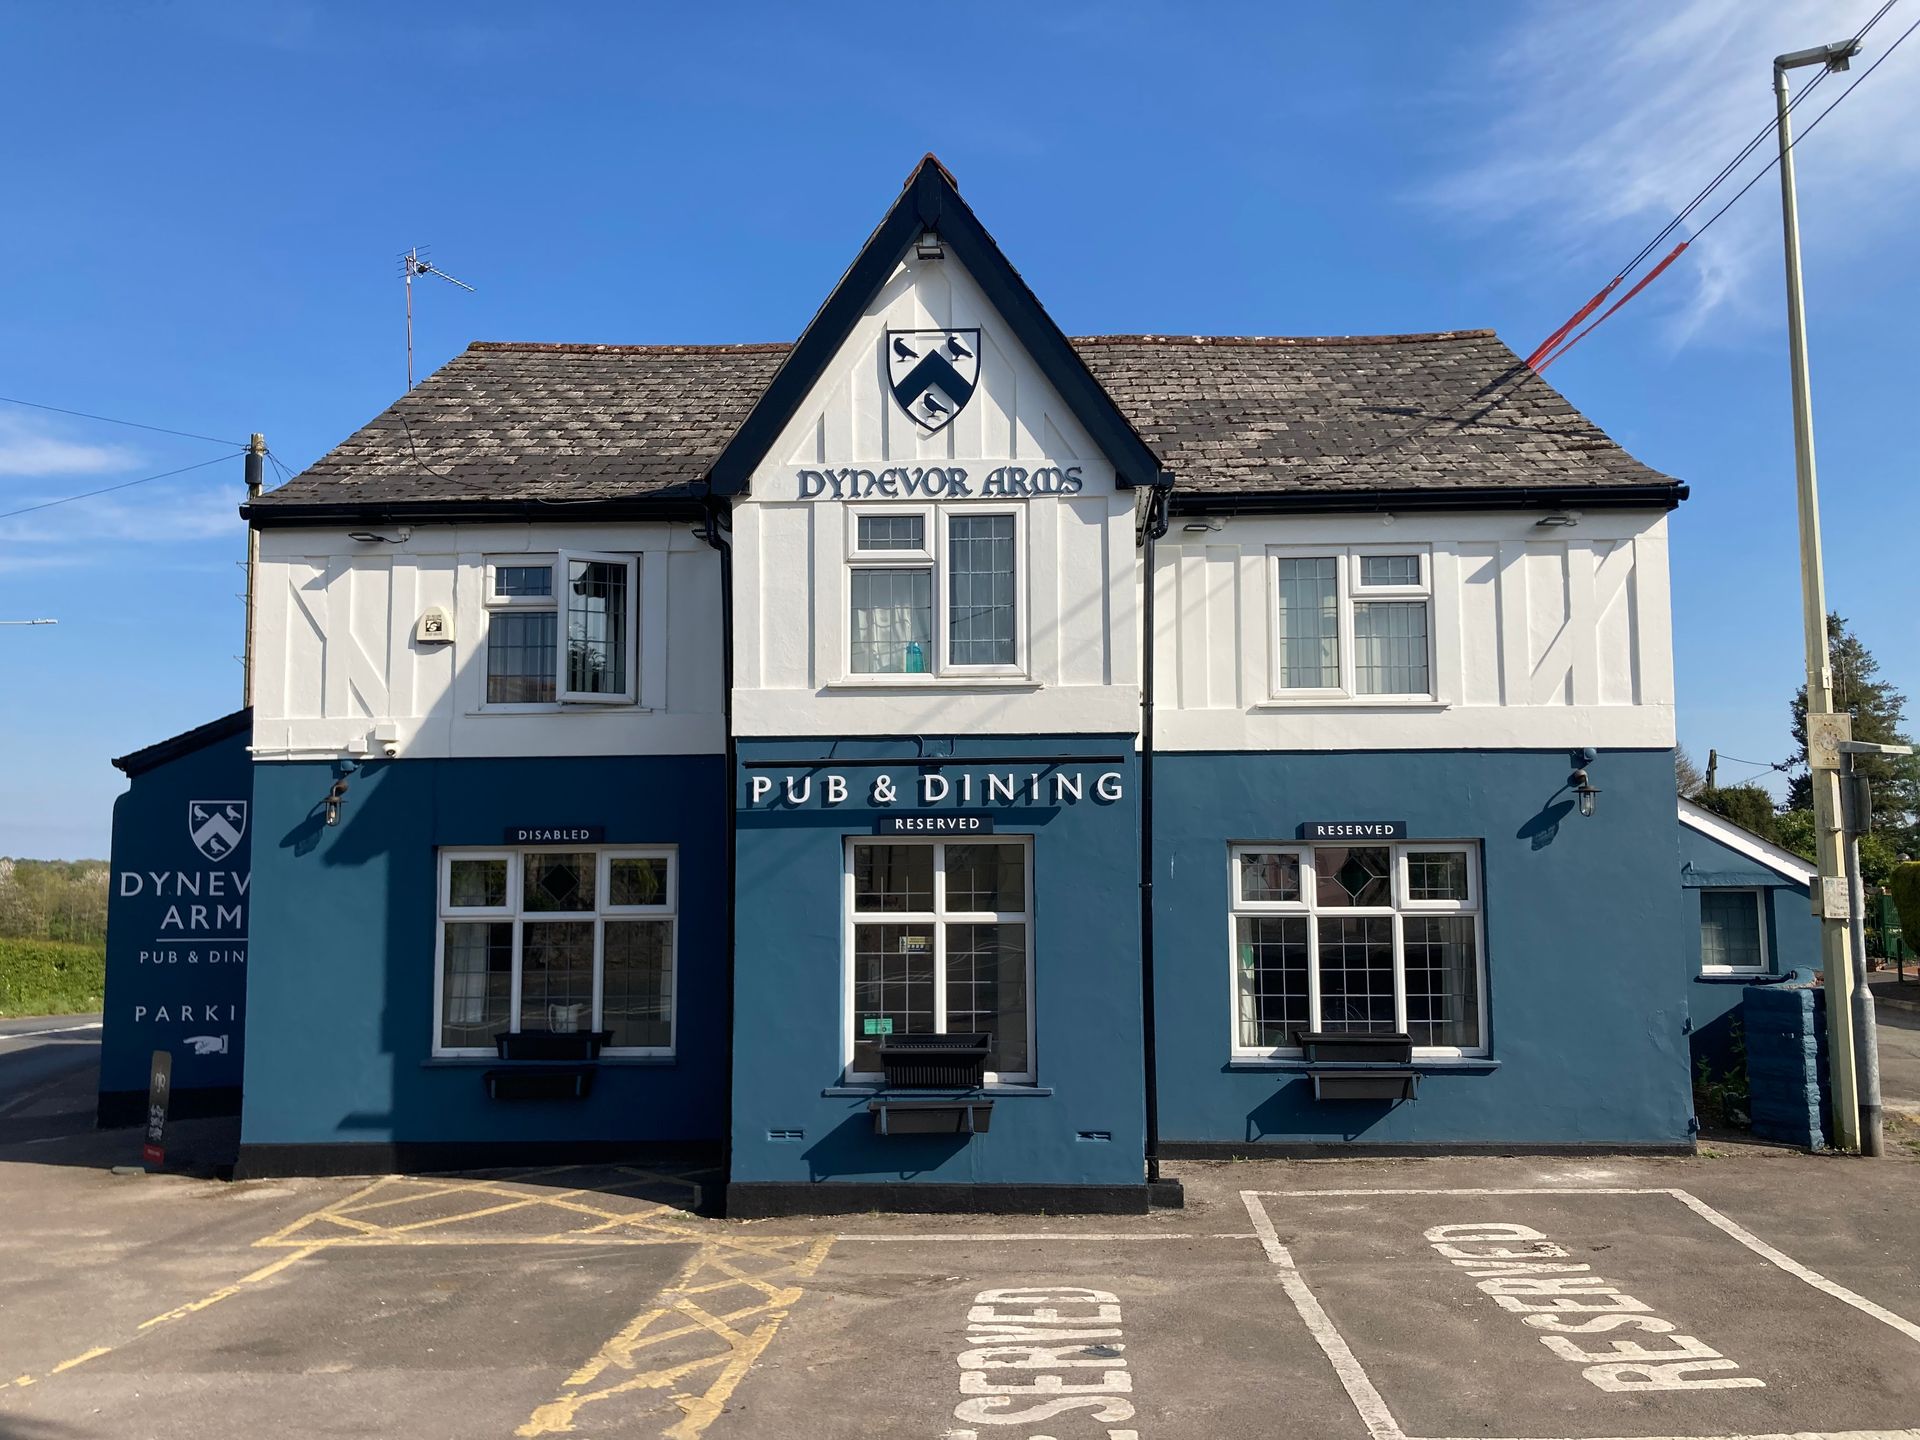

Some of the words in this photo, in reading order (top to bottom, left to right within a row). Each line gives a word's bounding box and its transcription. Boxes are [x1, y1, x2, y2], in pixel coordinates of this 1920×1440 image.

[797, 465, 972, 500] DYNEVOR
[980, 465, 1083, 498] ARMS
[751, 775, 848, 803] PUB
[873, 774, 897, 802] &
[923, 772, 1123, 801] DINING
[518, 829, 590, 840] DISABLED
[895, 818, 980, 830] RESERVED
[1317, 825, 1394, 836] RESERVED
[120, 871, 251, 897] DYNEV
[160, 904, 242, 930] ARM
[140, 950, 178, 964] PUB
[187, 950, 199, 964] &
[209, 950, 245, 963] DIN
[135, 1004, 236, 1023] PARKI
[1423, 1223, 1766, 1392] RESERVED
